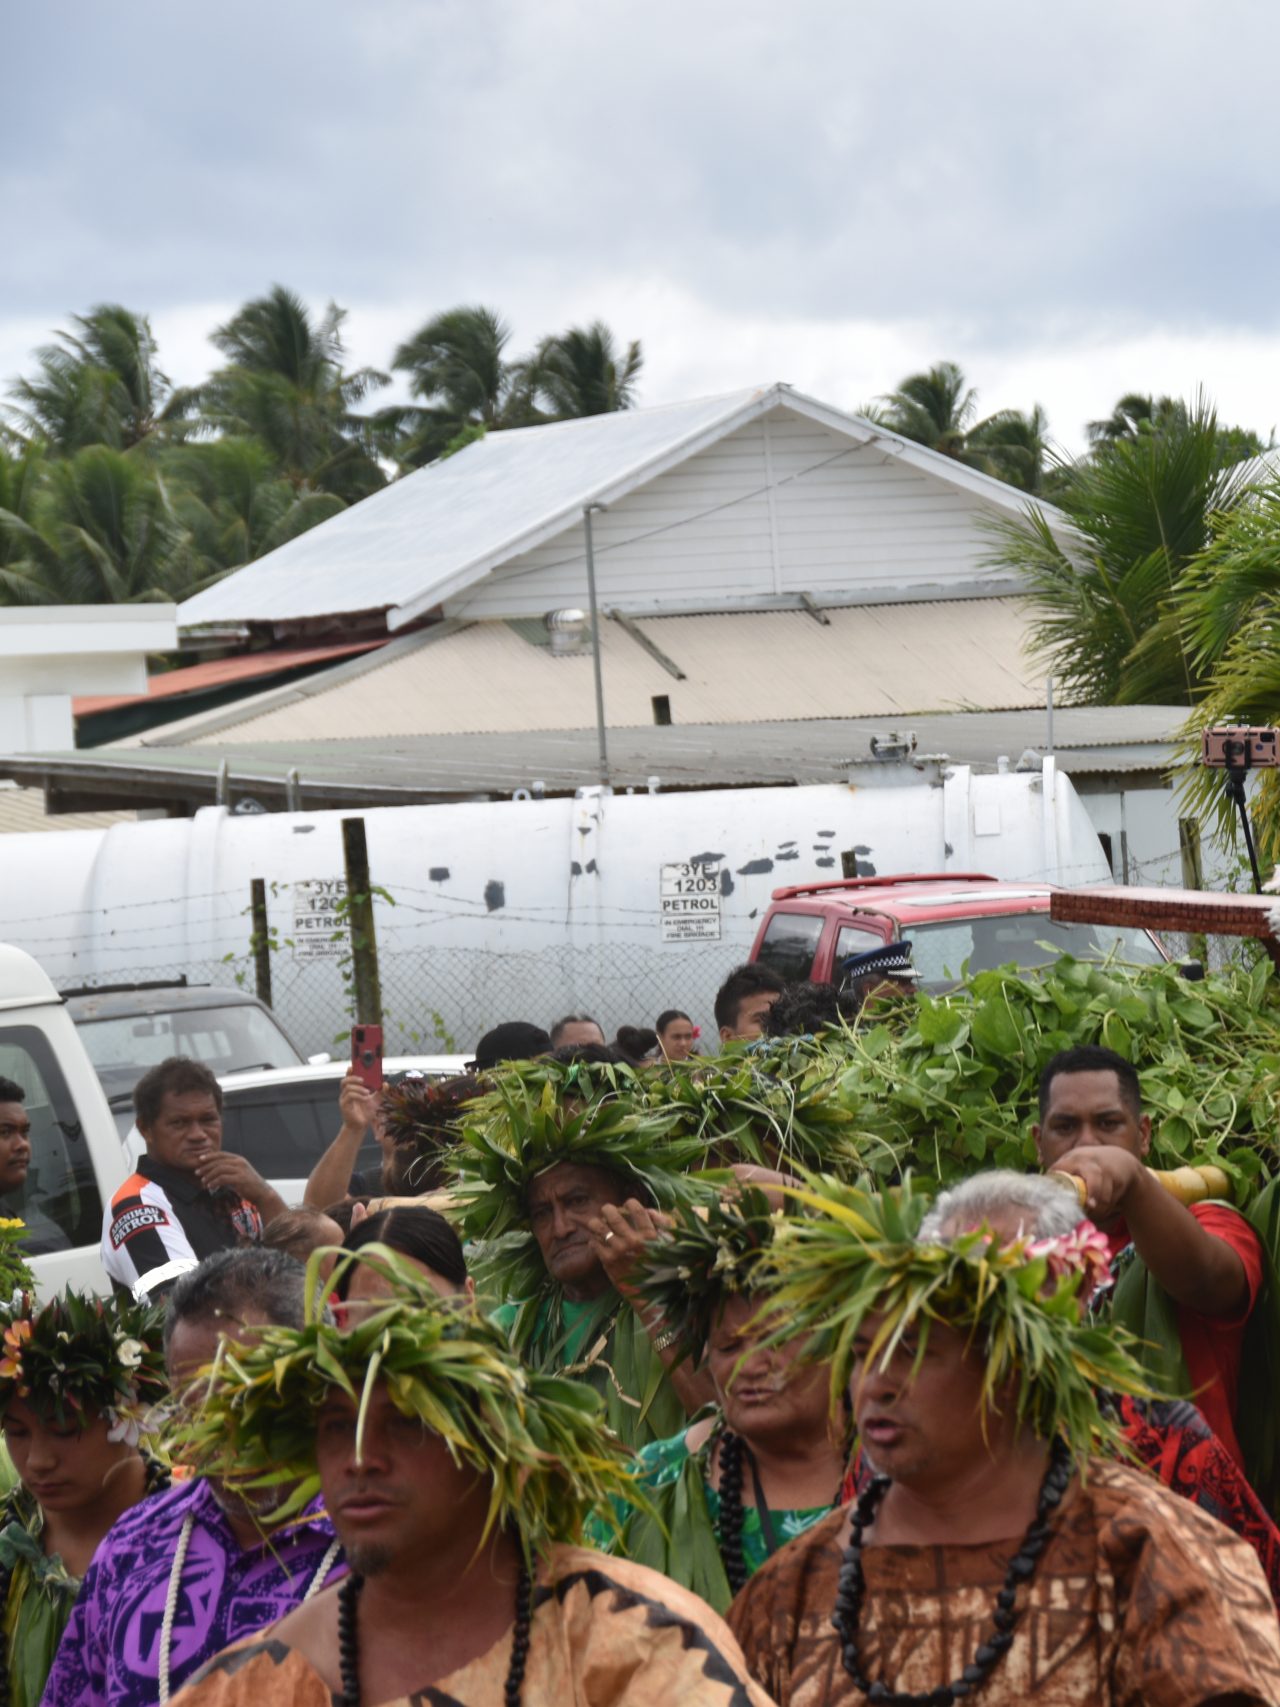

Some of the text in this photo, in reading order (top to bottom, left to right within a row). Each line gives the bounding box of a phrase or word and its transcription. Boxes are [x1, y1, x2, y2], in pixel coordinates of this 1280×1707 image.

[681, 863, 712, 877] 3YE
[674, 878, 717, 893] 1203
[663, 899, 718, 911] PETROL
[113, 1214, 165, 1246] PATROL
